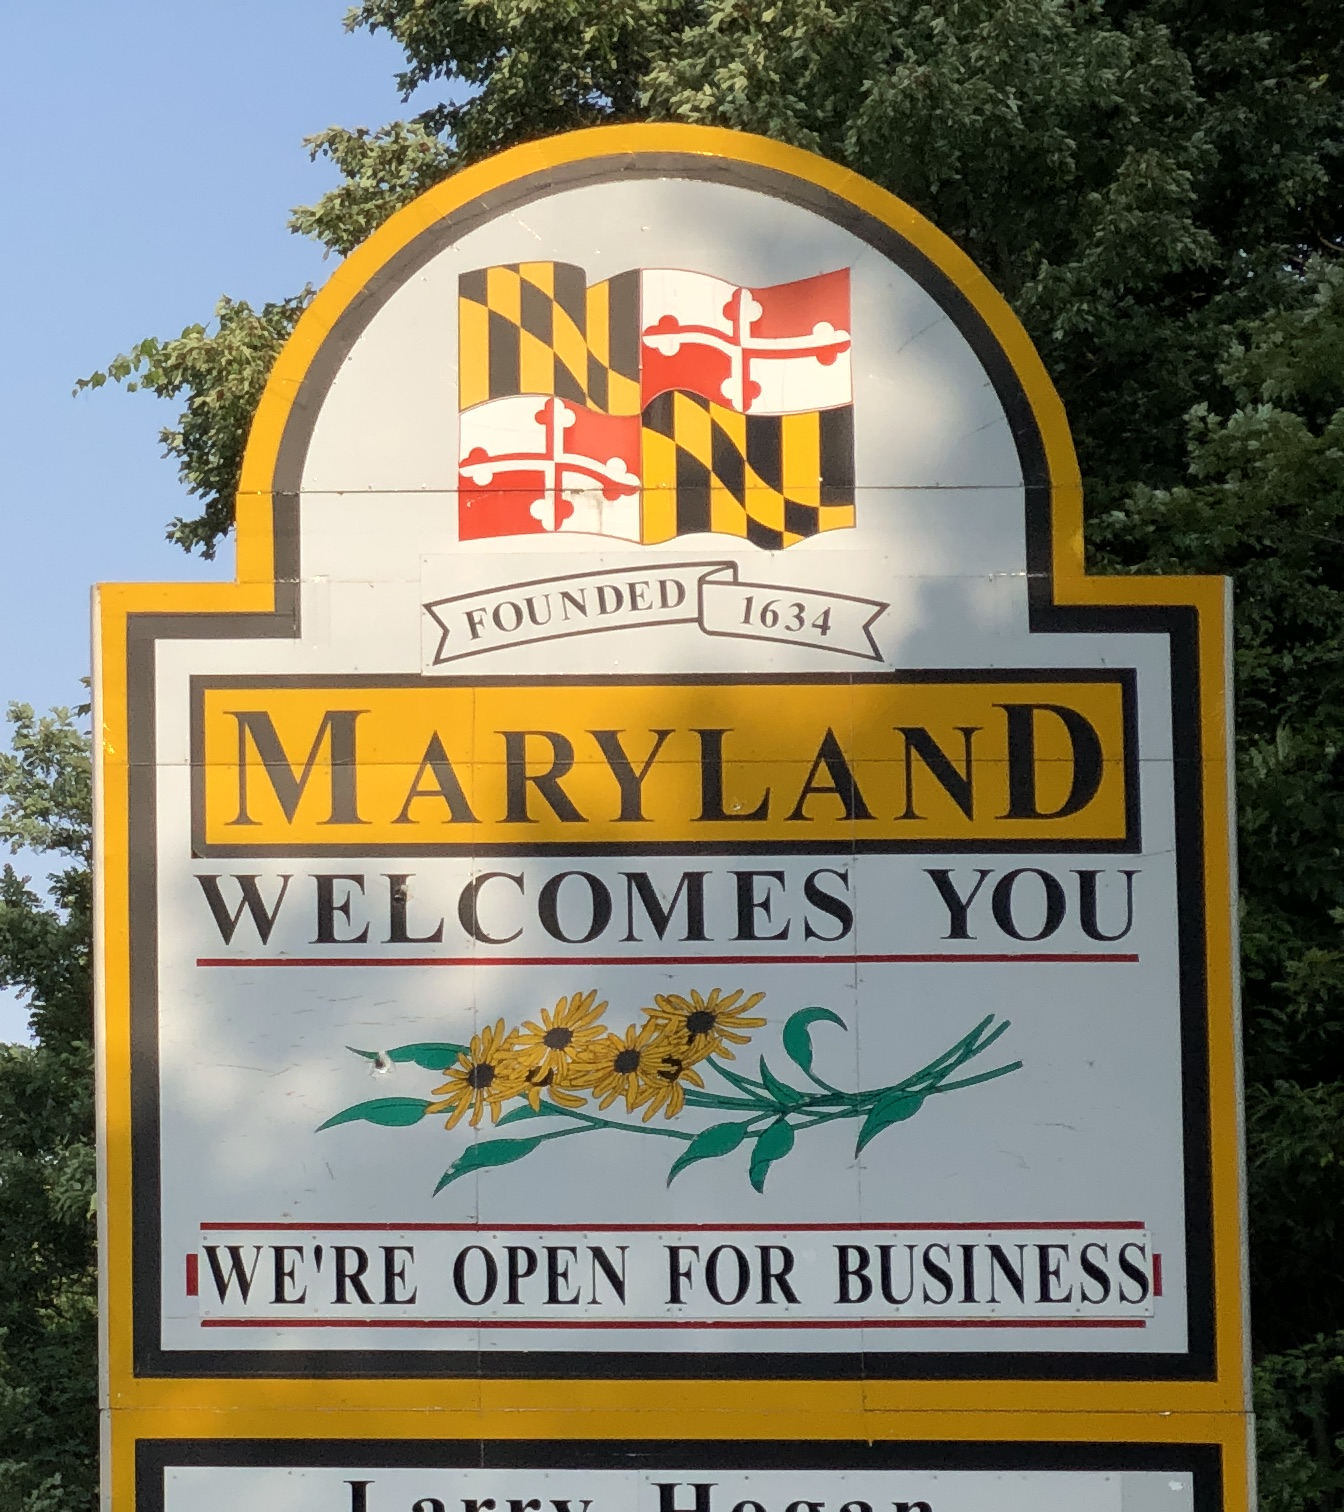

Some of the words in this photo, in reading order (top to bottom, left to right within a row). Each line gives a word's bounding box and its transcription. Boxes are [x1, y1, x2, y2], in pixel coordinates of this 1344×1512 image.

[463, 578, 687, 641] FOUNDED
[739, 593, 833, 638] 1634
[192, 868, 855, 946] WELCOMES
[934, 867, 1143, 942] YOU
[201, 1244, 418, 1306] WE'RE
[452, 1244, 631, 1306] OPEN
[665, 1244, 798, 1306] FOR
[833, 1242, 1151, 1306] BUSINESS
